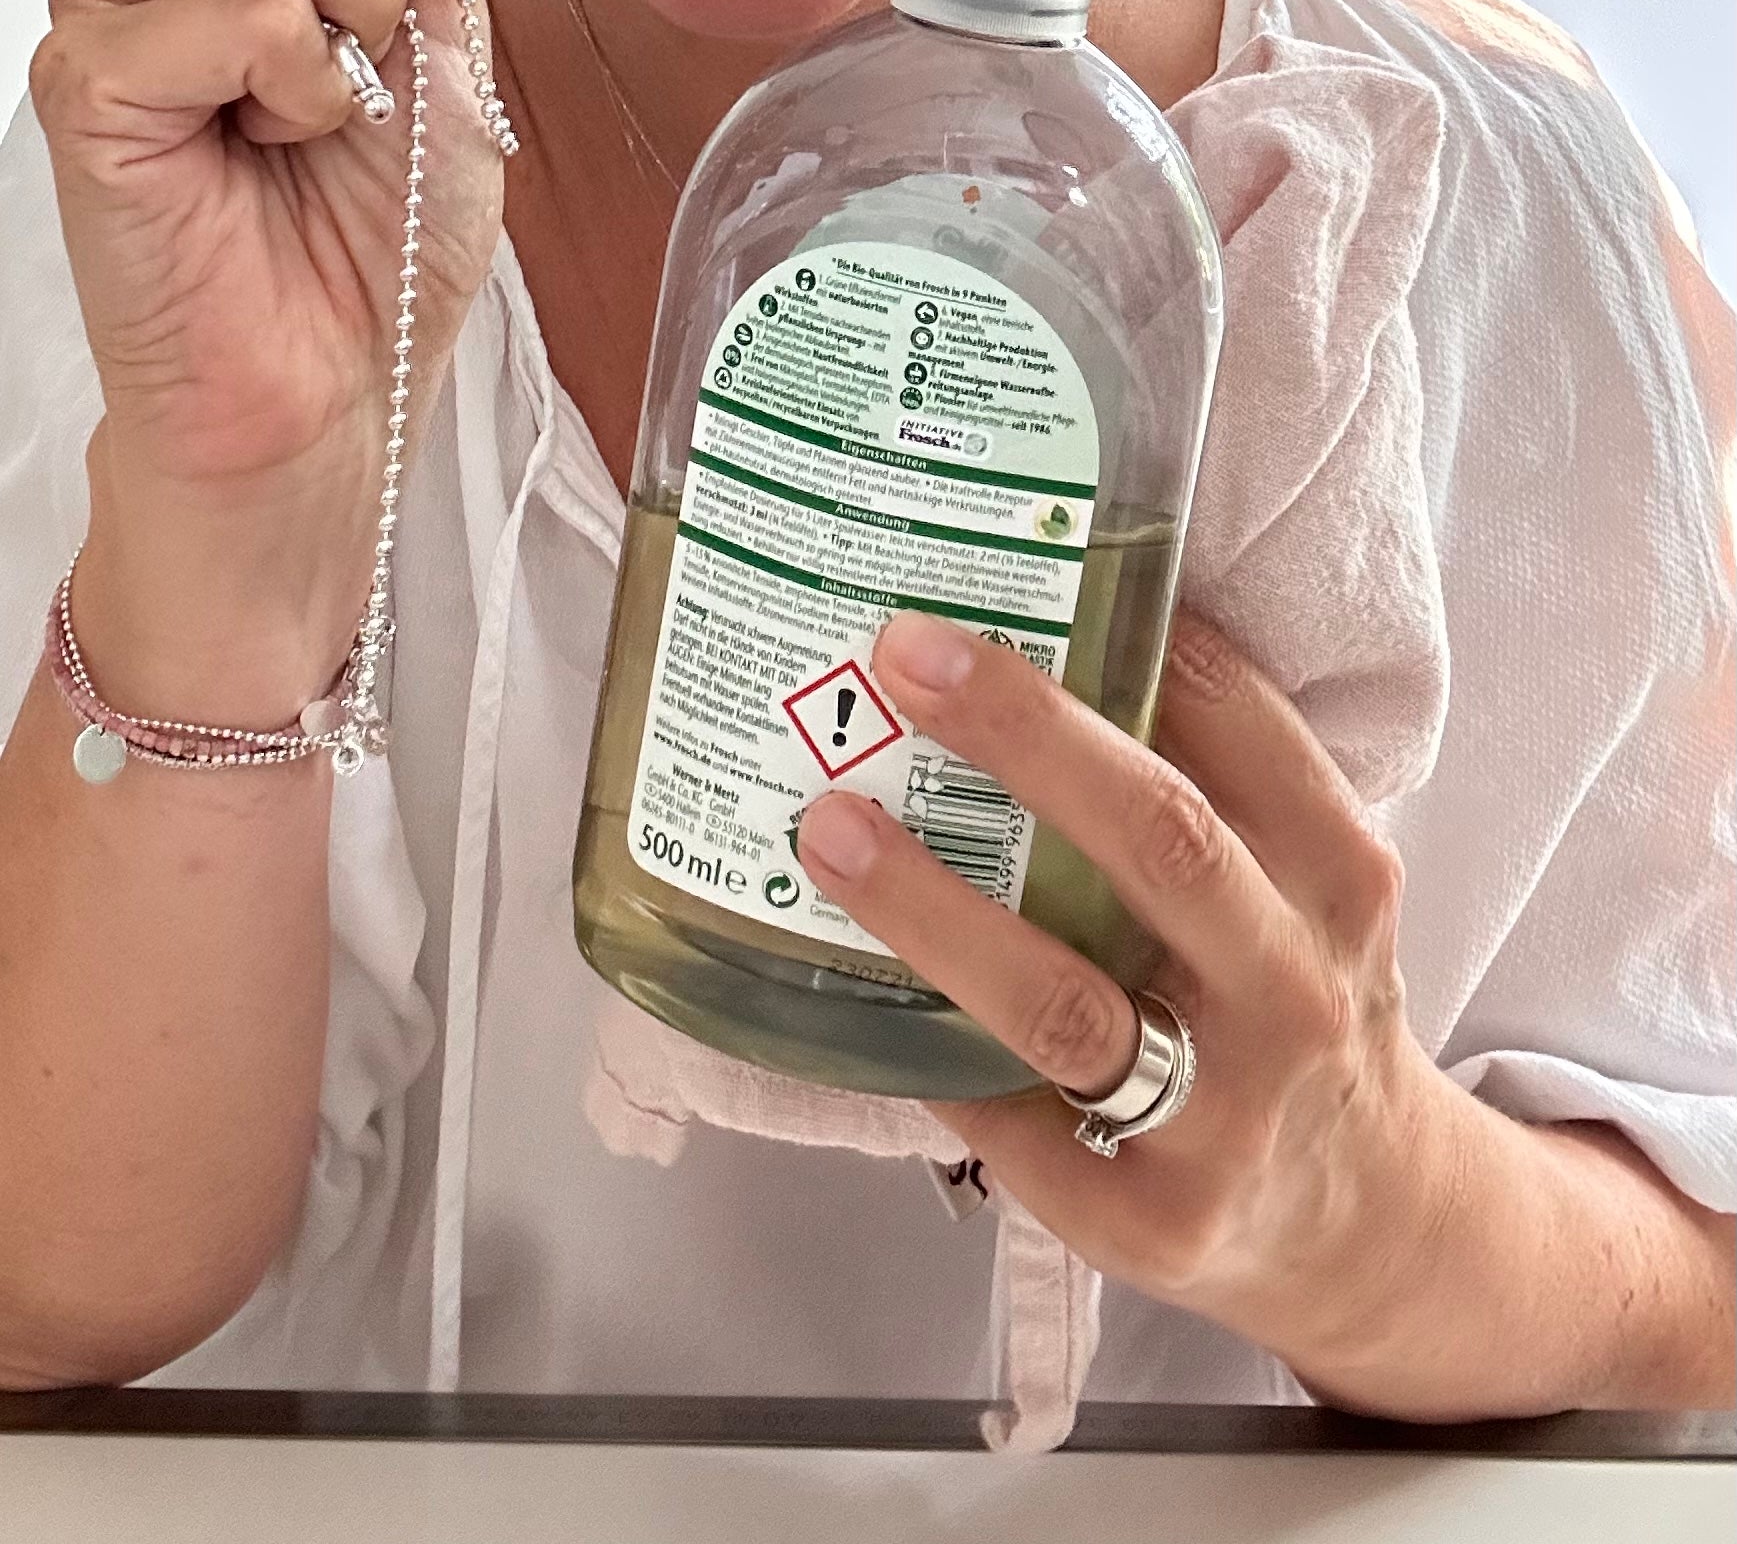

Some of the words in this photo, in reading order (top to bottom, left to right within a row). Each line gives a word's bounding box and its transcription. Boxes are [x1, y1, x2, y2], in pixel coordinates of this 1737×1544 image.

[905, 278, 920, 288] von
[922, 280, 950, 295] Frosch
[951, 287, 960, 298] in
[969, 291, 1007, 306] Punkten
[999, 342, 1049, 359] Produktion
[901, 420, 964, 438] INITIATIVE
[841, 440, 929, 471] Eigenschaften
[933, 481, 949, 493] Die
[993, 491, 1033, 507] Rezeptur
[835, 504, 910, 532] Anwendung
[1011, 573, 1047, 585] werden
[820, 578, 898, 606] Inhaltsstoffe
[1020, 641, 1055, 656] MIKRO
[720, 648, 758, 672] KONTAKT
[760, 663, 777, 679] MIT
[779, 670, 799, 687] DEN
[752, 681, 772, 700] lang
[710, 742, 738, 762] Frosch
[672, 763, 703, 788] Werner
[730, 766, 804, 799] www.frosch.eco
[710, 798, 736, 818] GmbH
[639, 824, 684, 867] 500
[688, 855, 722, 886] ml
[810, 907, 850, 926] Germany
